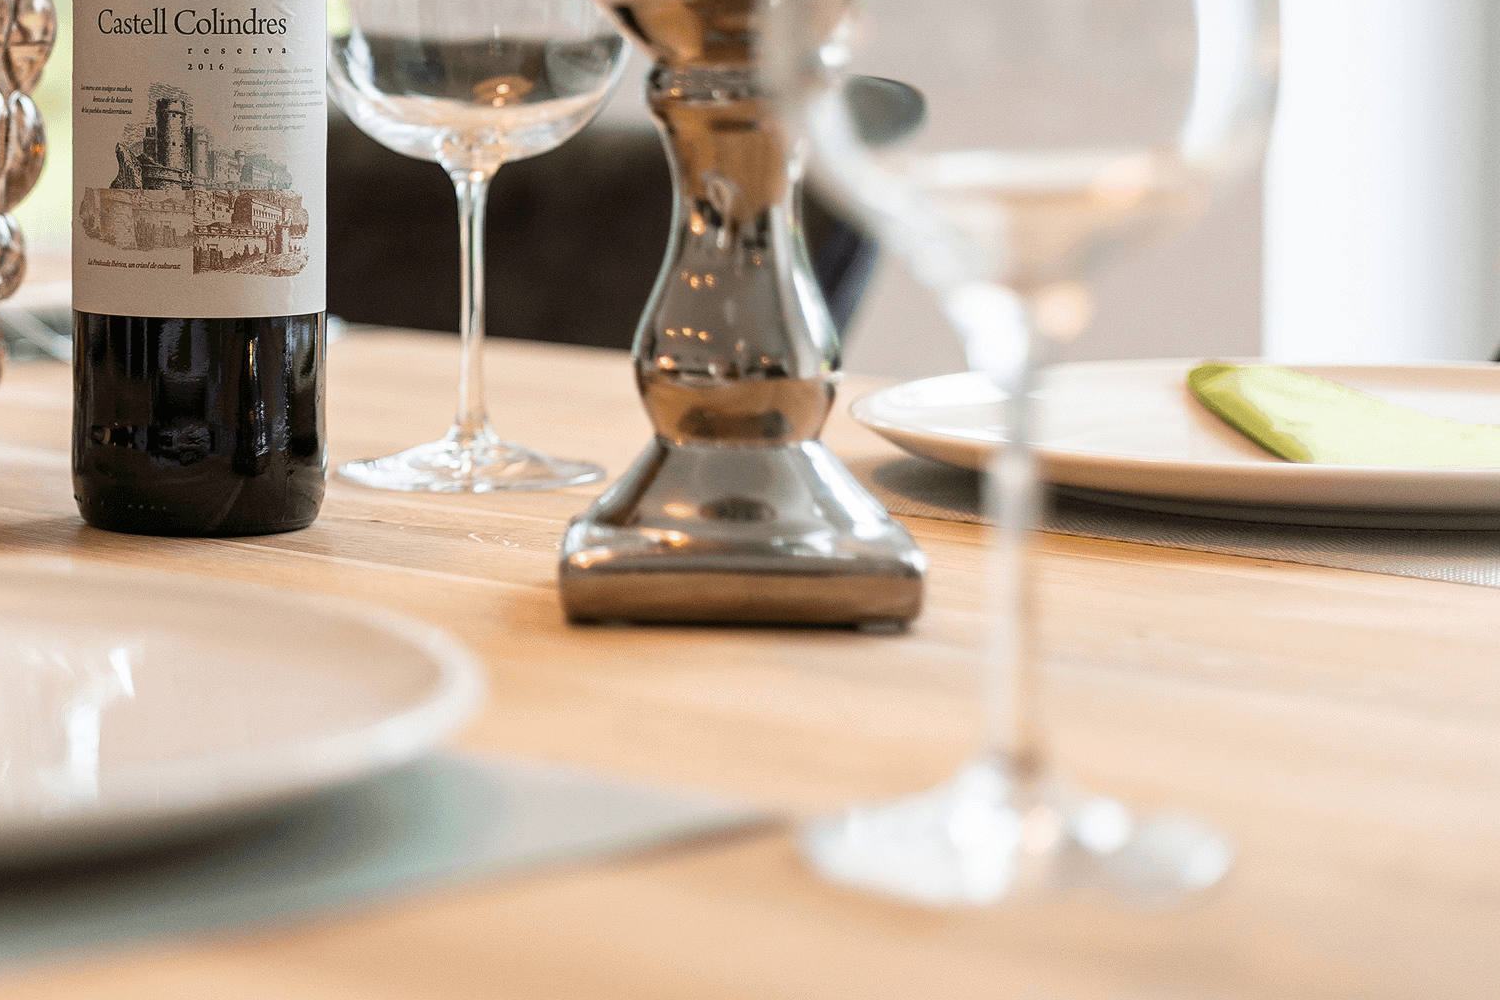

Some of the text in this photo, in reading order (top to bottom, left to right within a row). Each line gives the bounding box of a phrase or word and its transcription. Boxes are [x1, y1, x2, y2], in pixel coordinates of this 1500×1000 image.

[98, 7, 287, 35] Castell Colindres
[187, 47, 287, 55] reserva
[187, 63, 224, 71] 2016
[232, 124, 245, 133] Hoy
[135, 261, 150, 269] crisol
